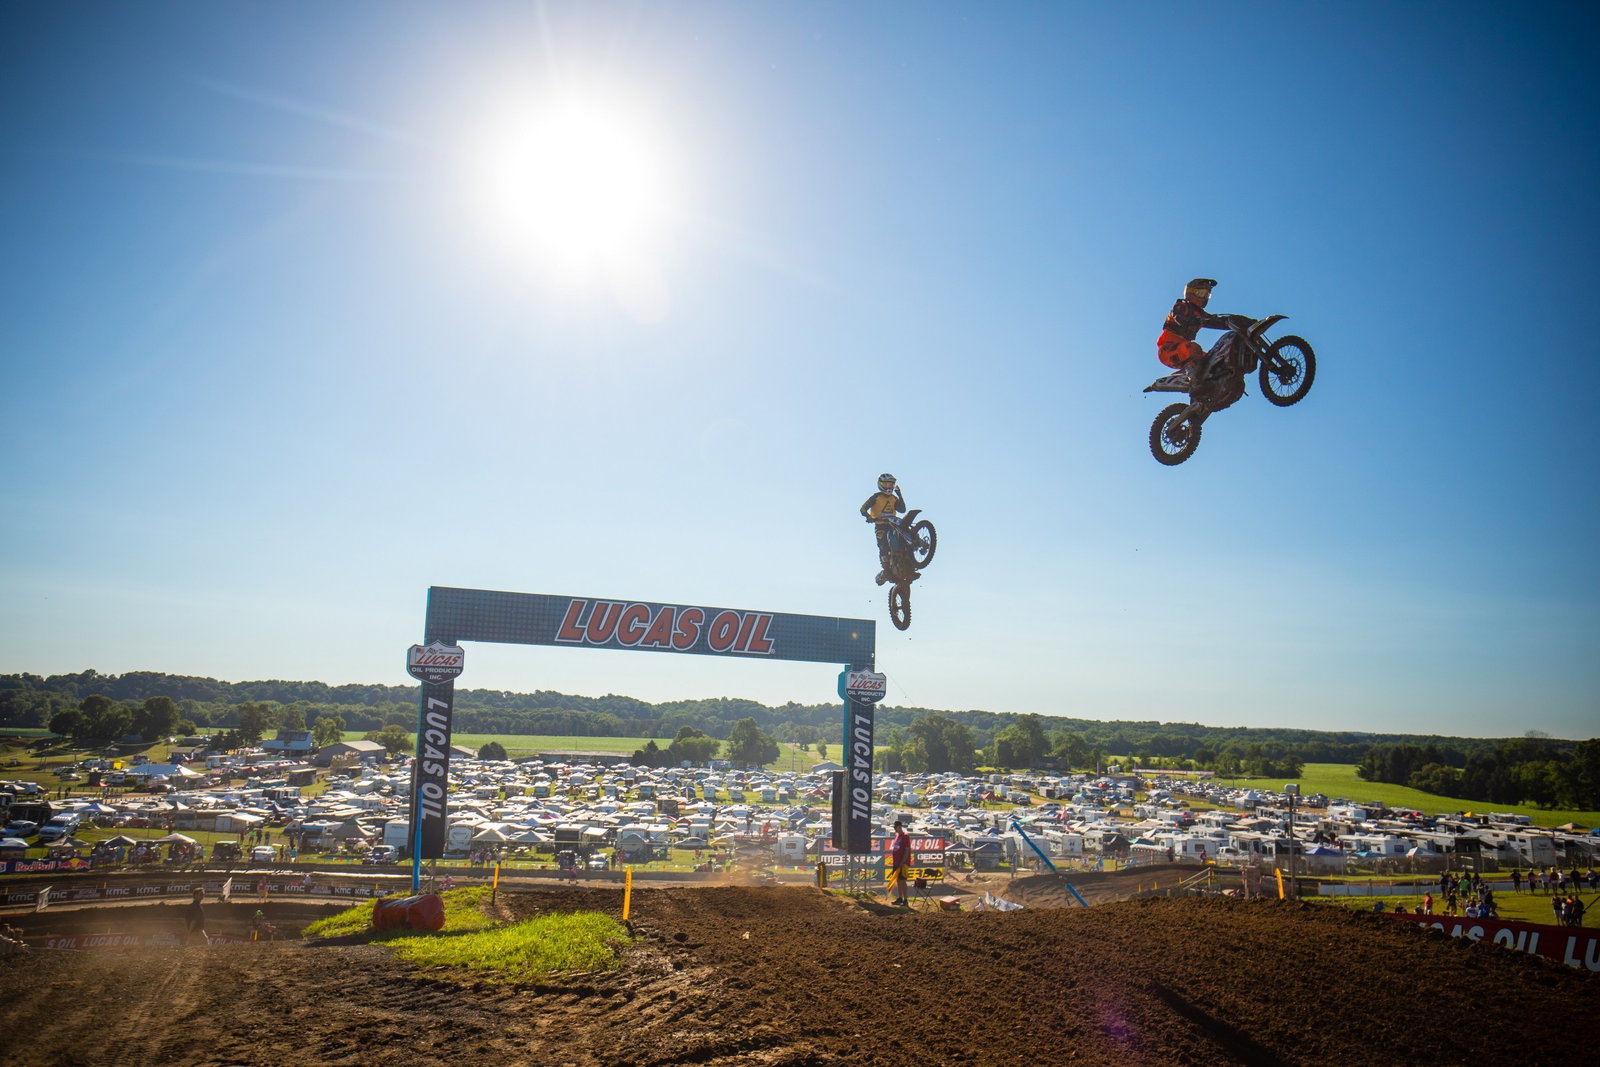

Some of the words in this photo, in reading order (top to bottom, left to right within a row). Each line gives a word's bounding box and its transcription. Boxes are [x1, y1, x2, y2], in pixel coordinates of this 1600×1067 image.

[555, 599, 705, 650] LUCAS
[708, 610, 774, 654] OIL
[415, 654, 461, 665] LUCAS
[850, 680, 884, 689] LUCAS
[422, 696, 449, 777] LUCAS
[853, 714, 871, 784] LUCAS
[421, 782, 443, 820] OIL
[852, 787, 869, 820] OIL
[924, 838, 940, 850] OIL
[917, 853, 944, 861] GEICO
[8, 893, 35, 902] KMC
[105, 888, 130, 896] KMC
[136, 886, 161, 894] KMC
[166, 884, 191, 892] KMC
[284, 884, 305, 892] KMC
[334, 887, 352, 895] KMC
[354, 888, 370, 896] KMC
[82, 936, 121, 947] LUCAS
